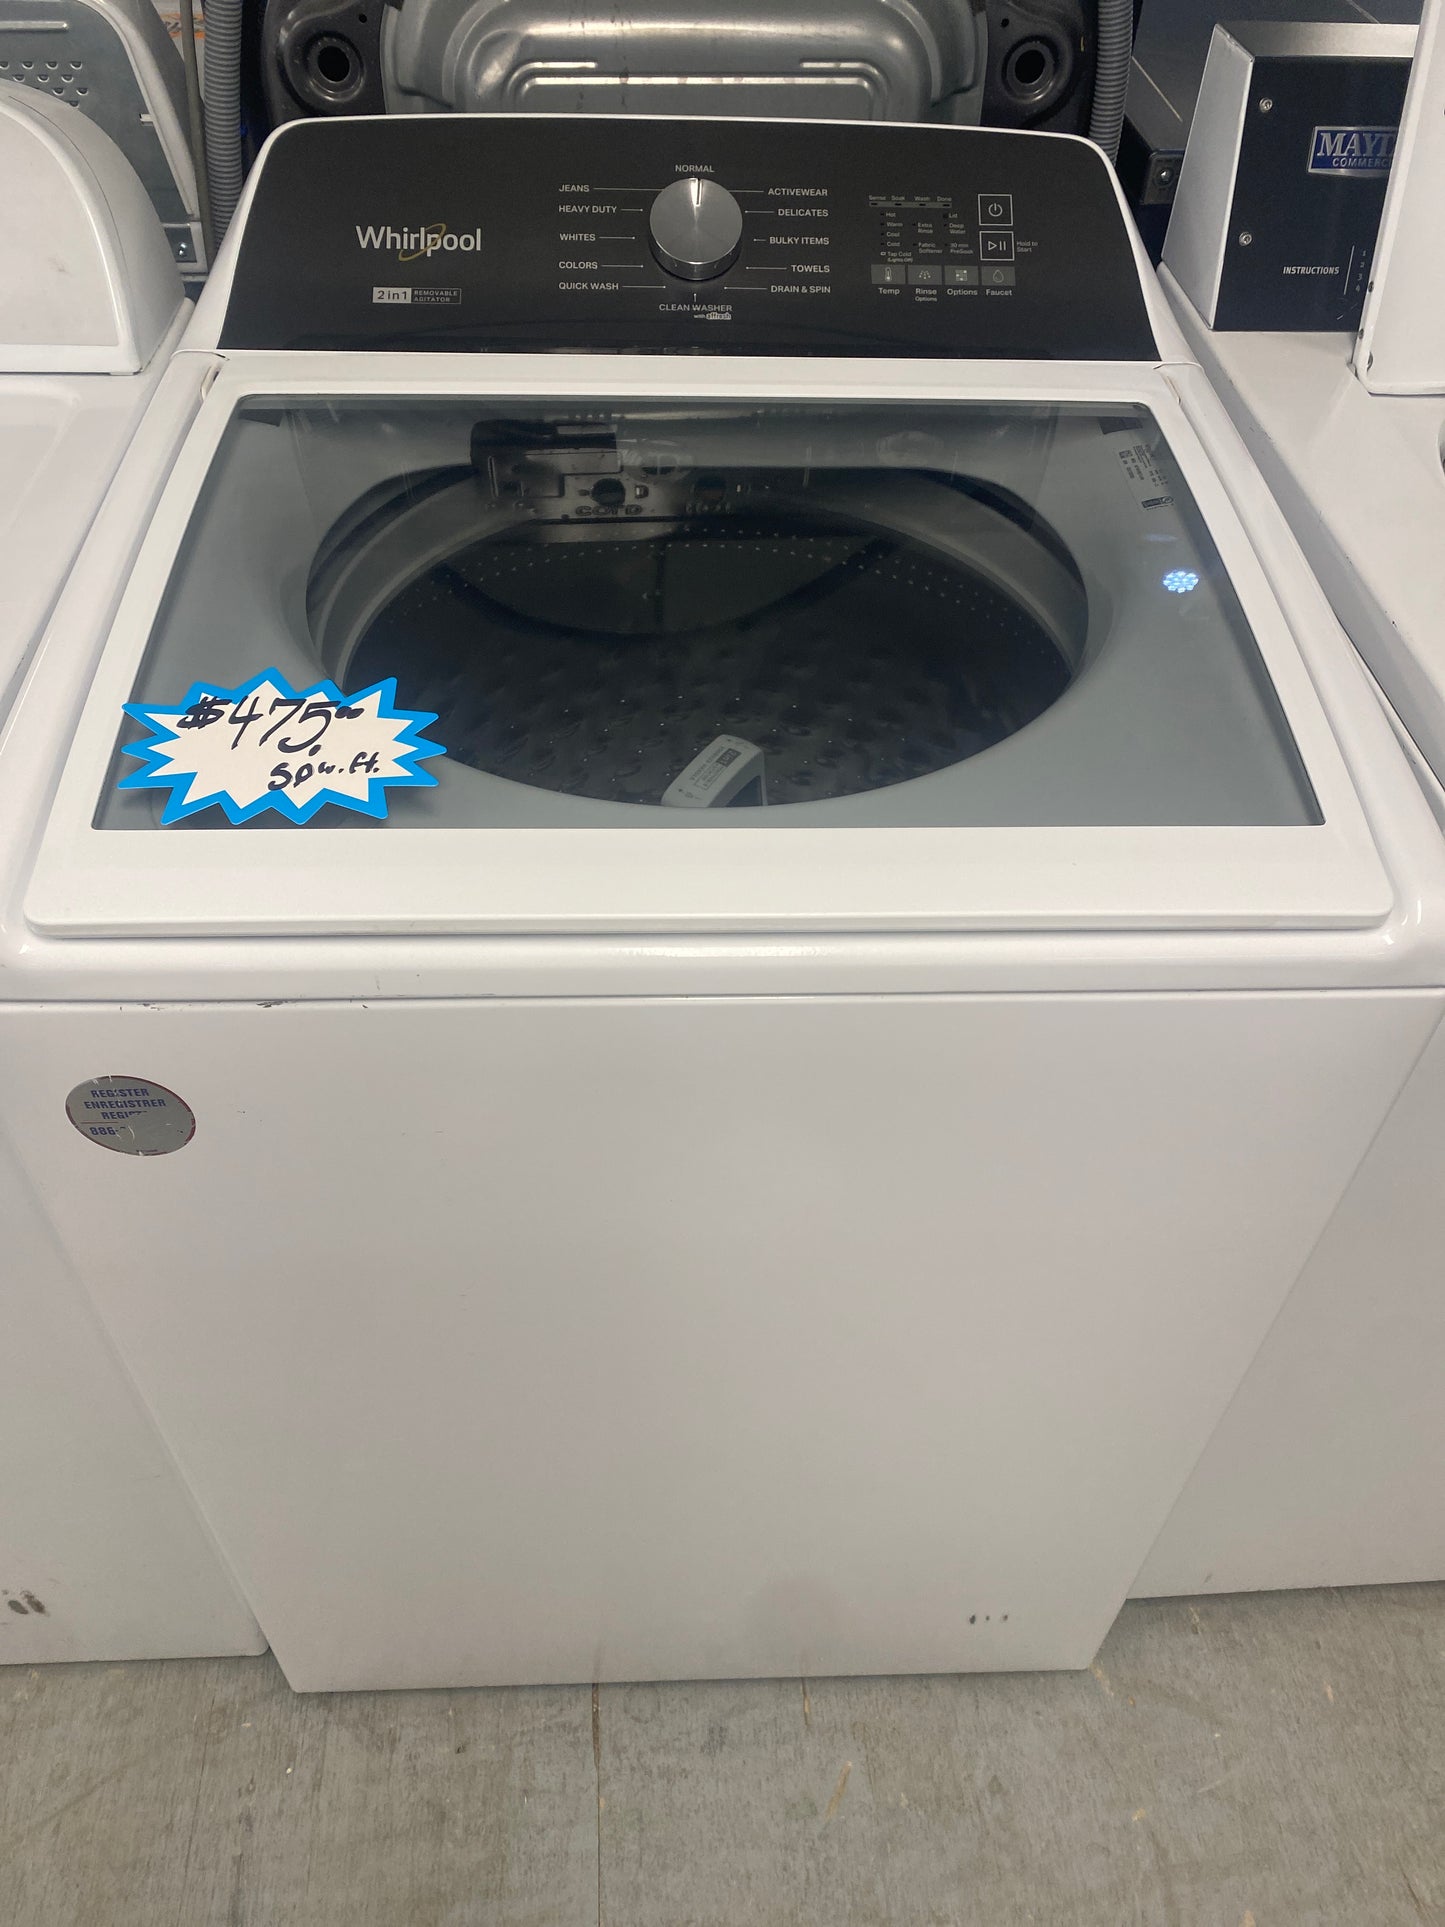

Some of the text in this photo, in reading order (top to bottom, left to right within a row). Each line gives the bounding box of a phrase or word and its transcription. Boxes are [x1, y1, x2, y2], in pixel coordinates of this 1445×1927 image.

[1316, 132, 1396, 156] MAYT
[1332, 158, 1391, 168] COMMERC
[675, 164, 714, 173] NORMAL
[768, 188, 828, 196] ACTIVEWEAR
[559, 205, 617, 213] HEAVY DUTY
[778, 208, 829, 217] DELICATES
[356, 225, 482, 257] Whirlpool
[560, 233, 596, 241] WHITES
[769, 236, 830, 245] BULKY ITEMS
[559, 261, 598, 270] COLORS
[791, 264, 830, 273] TOWELS
[1283, 266, 1340, 275] INSTRUCTIONS
[559, 282, 619, 291] QUICK WASH
[770, 285, 831, 294] DRAIN & SPIN
[414, 289, 458, 297] REMOVABLE
[878, 287, 901, 296] Temp
[947, 288, 978, 296] Options
[659, 303, 733, 312] CLEAN WASHER
[83, 1099, 167, 1109] ENREGISTRER
